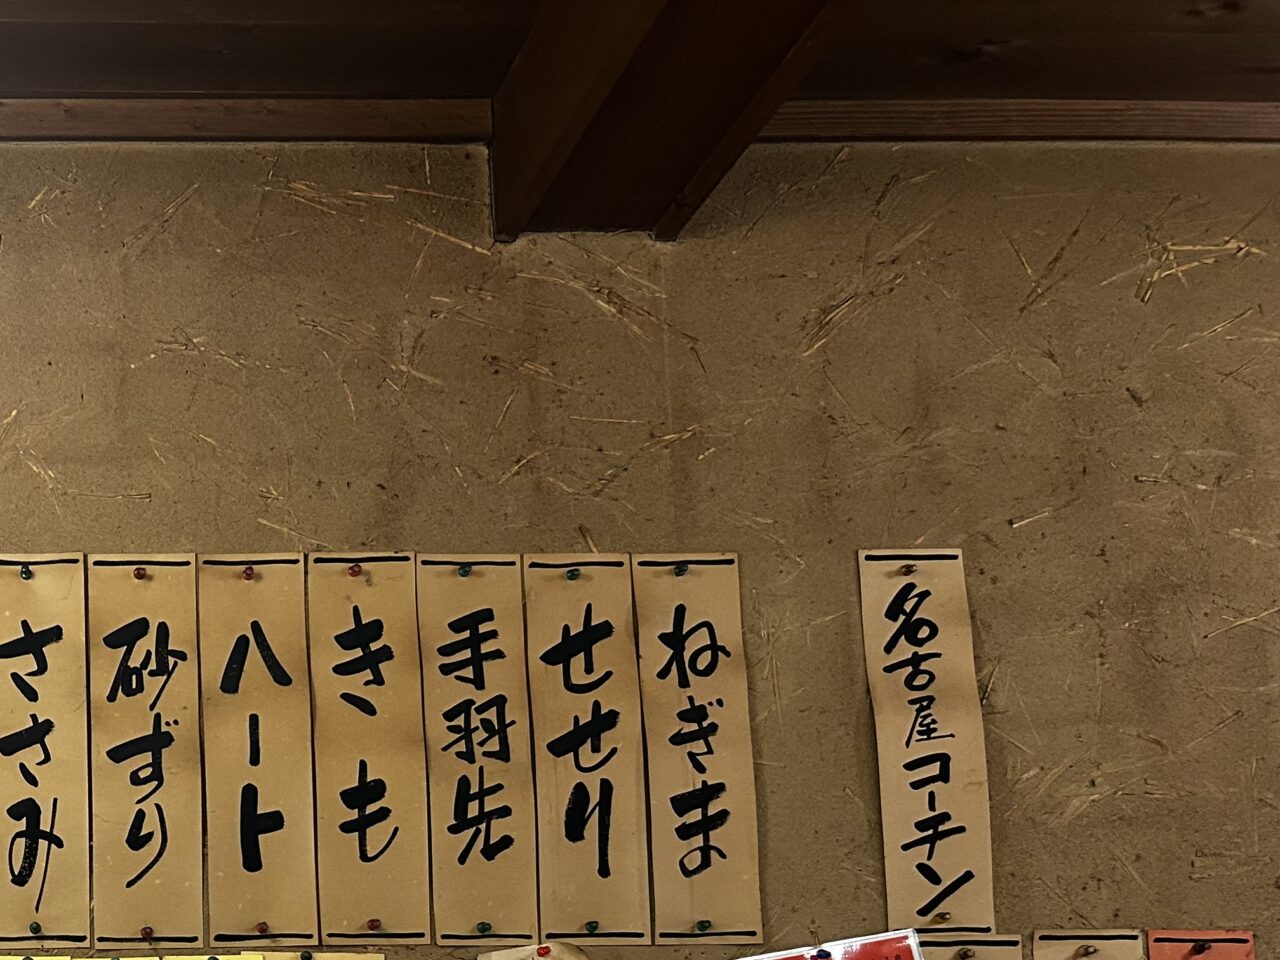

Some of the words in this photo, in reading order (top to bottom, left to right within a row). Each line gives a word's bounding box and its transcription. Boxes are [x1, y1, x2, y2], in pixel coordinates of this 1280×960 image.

[103, 617, 187, 888] 砂ずり
[220, 620, 292, 872] ハート
[332, 605, 399, 862] きも
[437, 608, 516, 865] 手羽先
[540, 604, 620, 878] せせり
[657, 604, 731, 877] ねぎま
[883, 582, 975, 917] 名古屋コーチン
